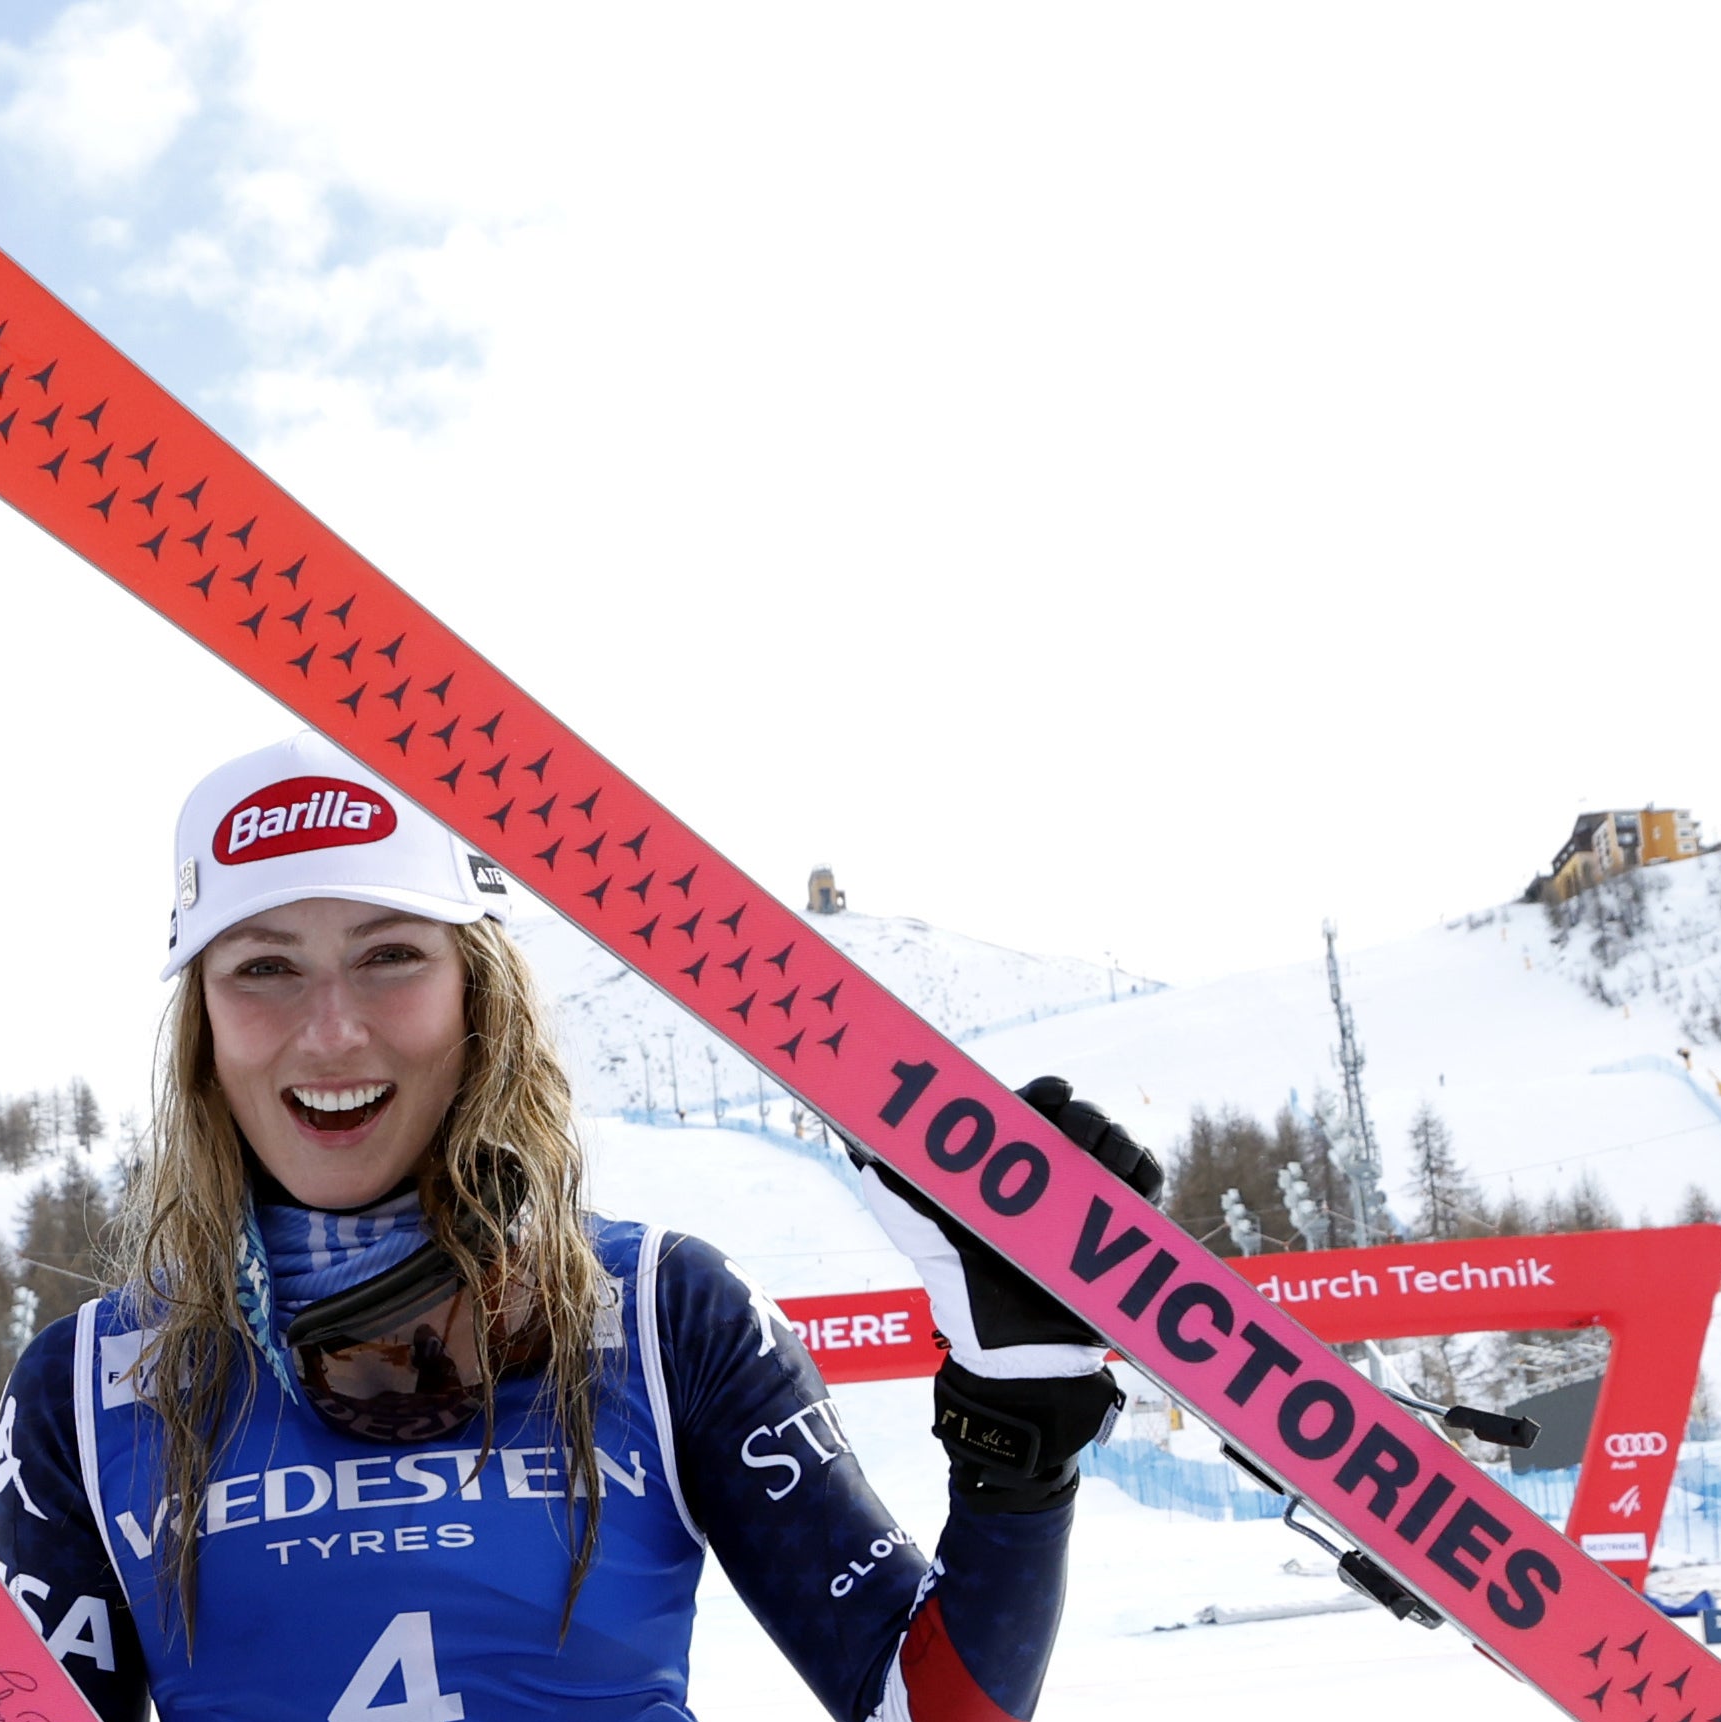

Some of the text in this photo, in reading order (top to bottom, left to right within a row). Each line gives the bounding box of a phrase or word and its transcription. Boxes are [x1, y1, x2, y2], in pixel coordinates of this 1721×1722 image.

[228, 790, 373, 854] Barilla
[1387, 1257, 1555, 1296] Technik
[790, 1311, 912, 1351] RIERE
[878, 1059, 1562, 1630] 100 VICTORIES
[265, 1522, 476, 1566] TYRES
